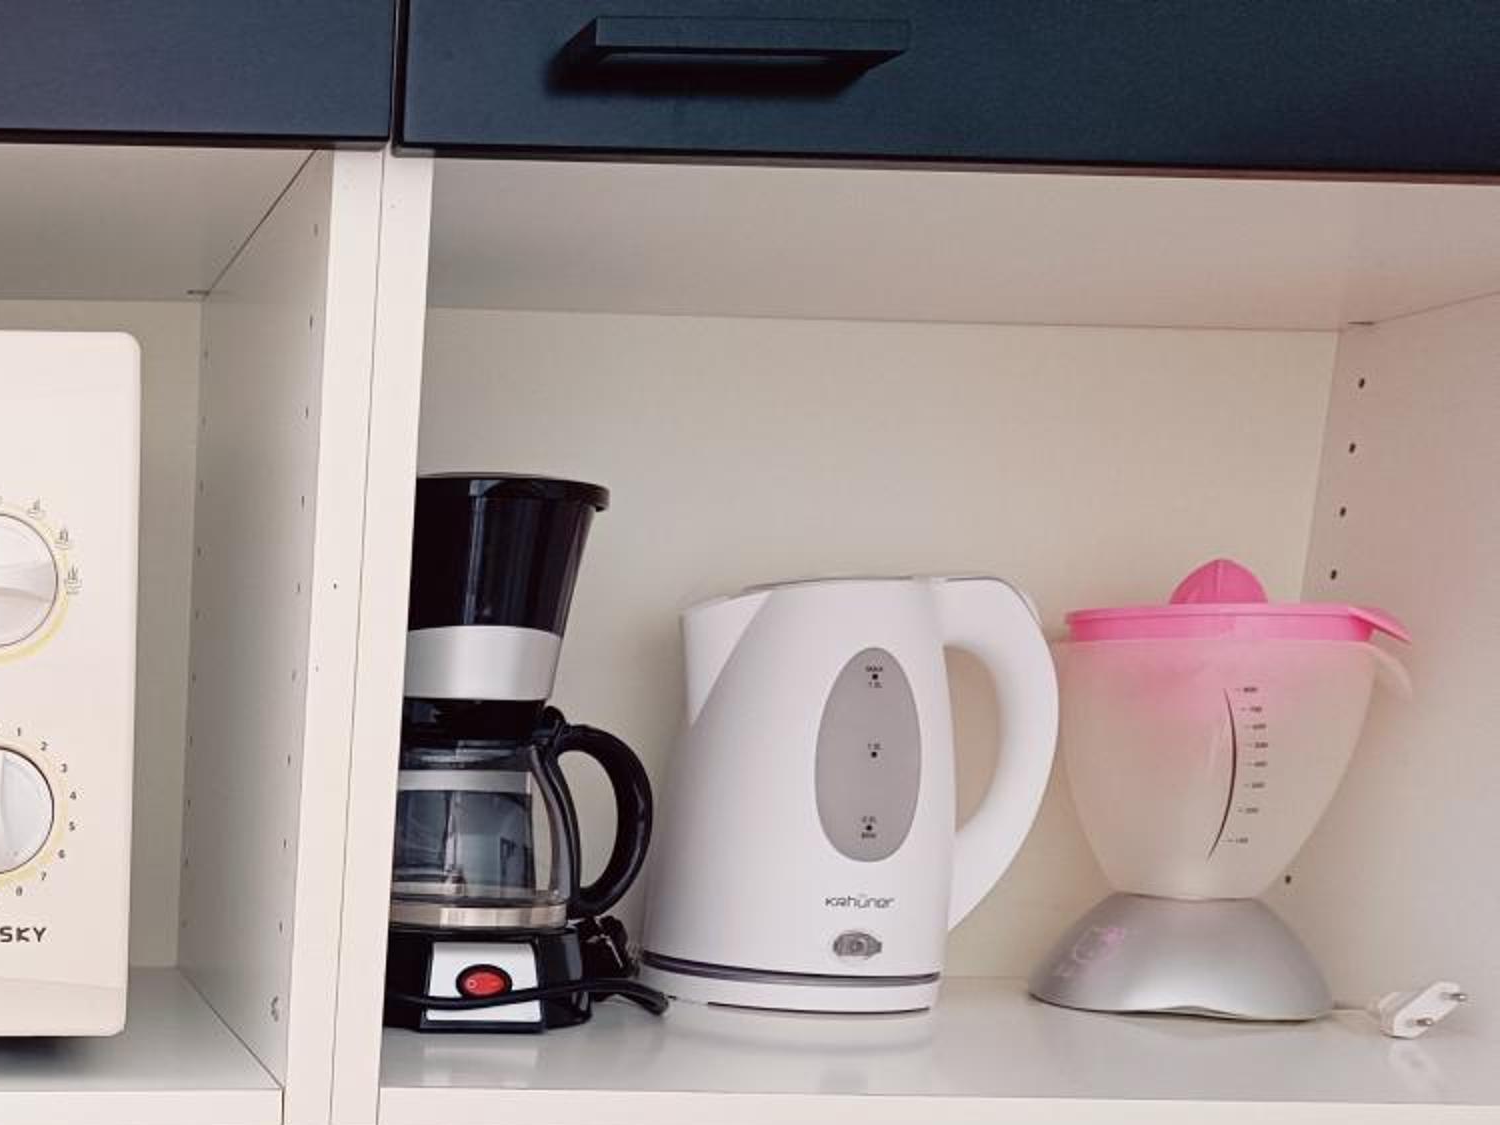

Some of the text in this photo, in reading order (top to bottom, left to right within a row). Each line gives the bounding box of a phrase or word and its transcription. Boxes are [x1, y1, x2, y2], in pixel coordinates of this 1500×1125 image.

[40, 741, 48, 752] 2
[61, 763, 68, 773] 3
[69, 791, 77, 801] 4
[69, 821, 76, 831] 5
[58, 849, 65, 859] 6
[41, 871, 47, 881] 7
